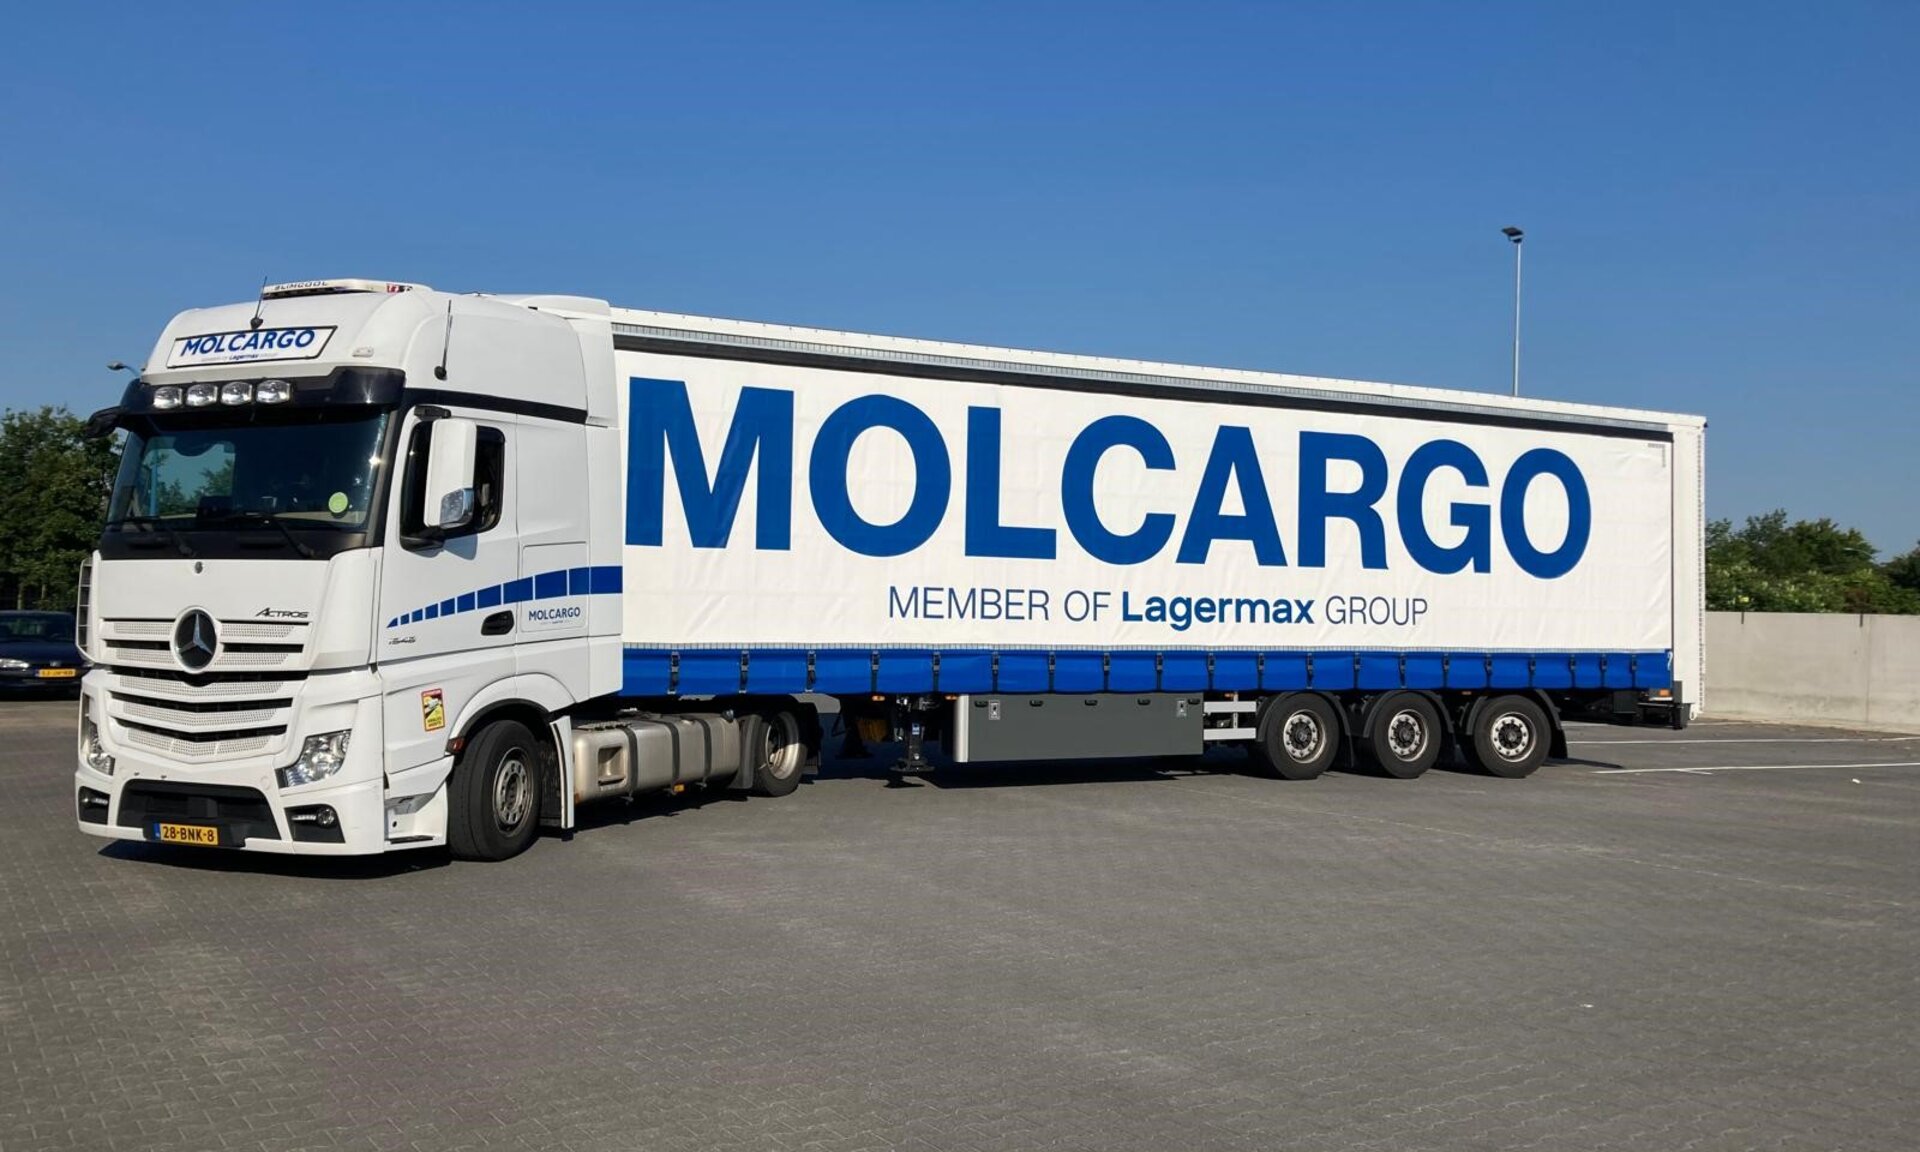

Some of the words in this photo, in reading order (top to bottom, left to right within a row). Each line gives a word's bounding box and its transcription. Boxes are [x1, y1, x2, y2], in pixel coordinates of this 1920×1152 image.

[180, 330, 315, 357] MOLCARGO
[625, 377, 1591, 580] MOLCARGO
[528, 607, 581, 621] MOLCARGO
[889, 585, 1050, 621] MEMBER
[1063, 589, 1112, 622] OF
[1121, 590, 1316, 632] Lagermax
[1325, 595, 1428, 626] GROUP
[162, 826, 215, 842] 28-BNK-8
